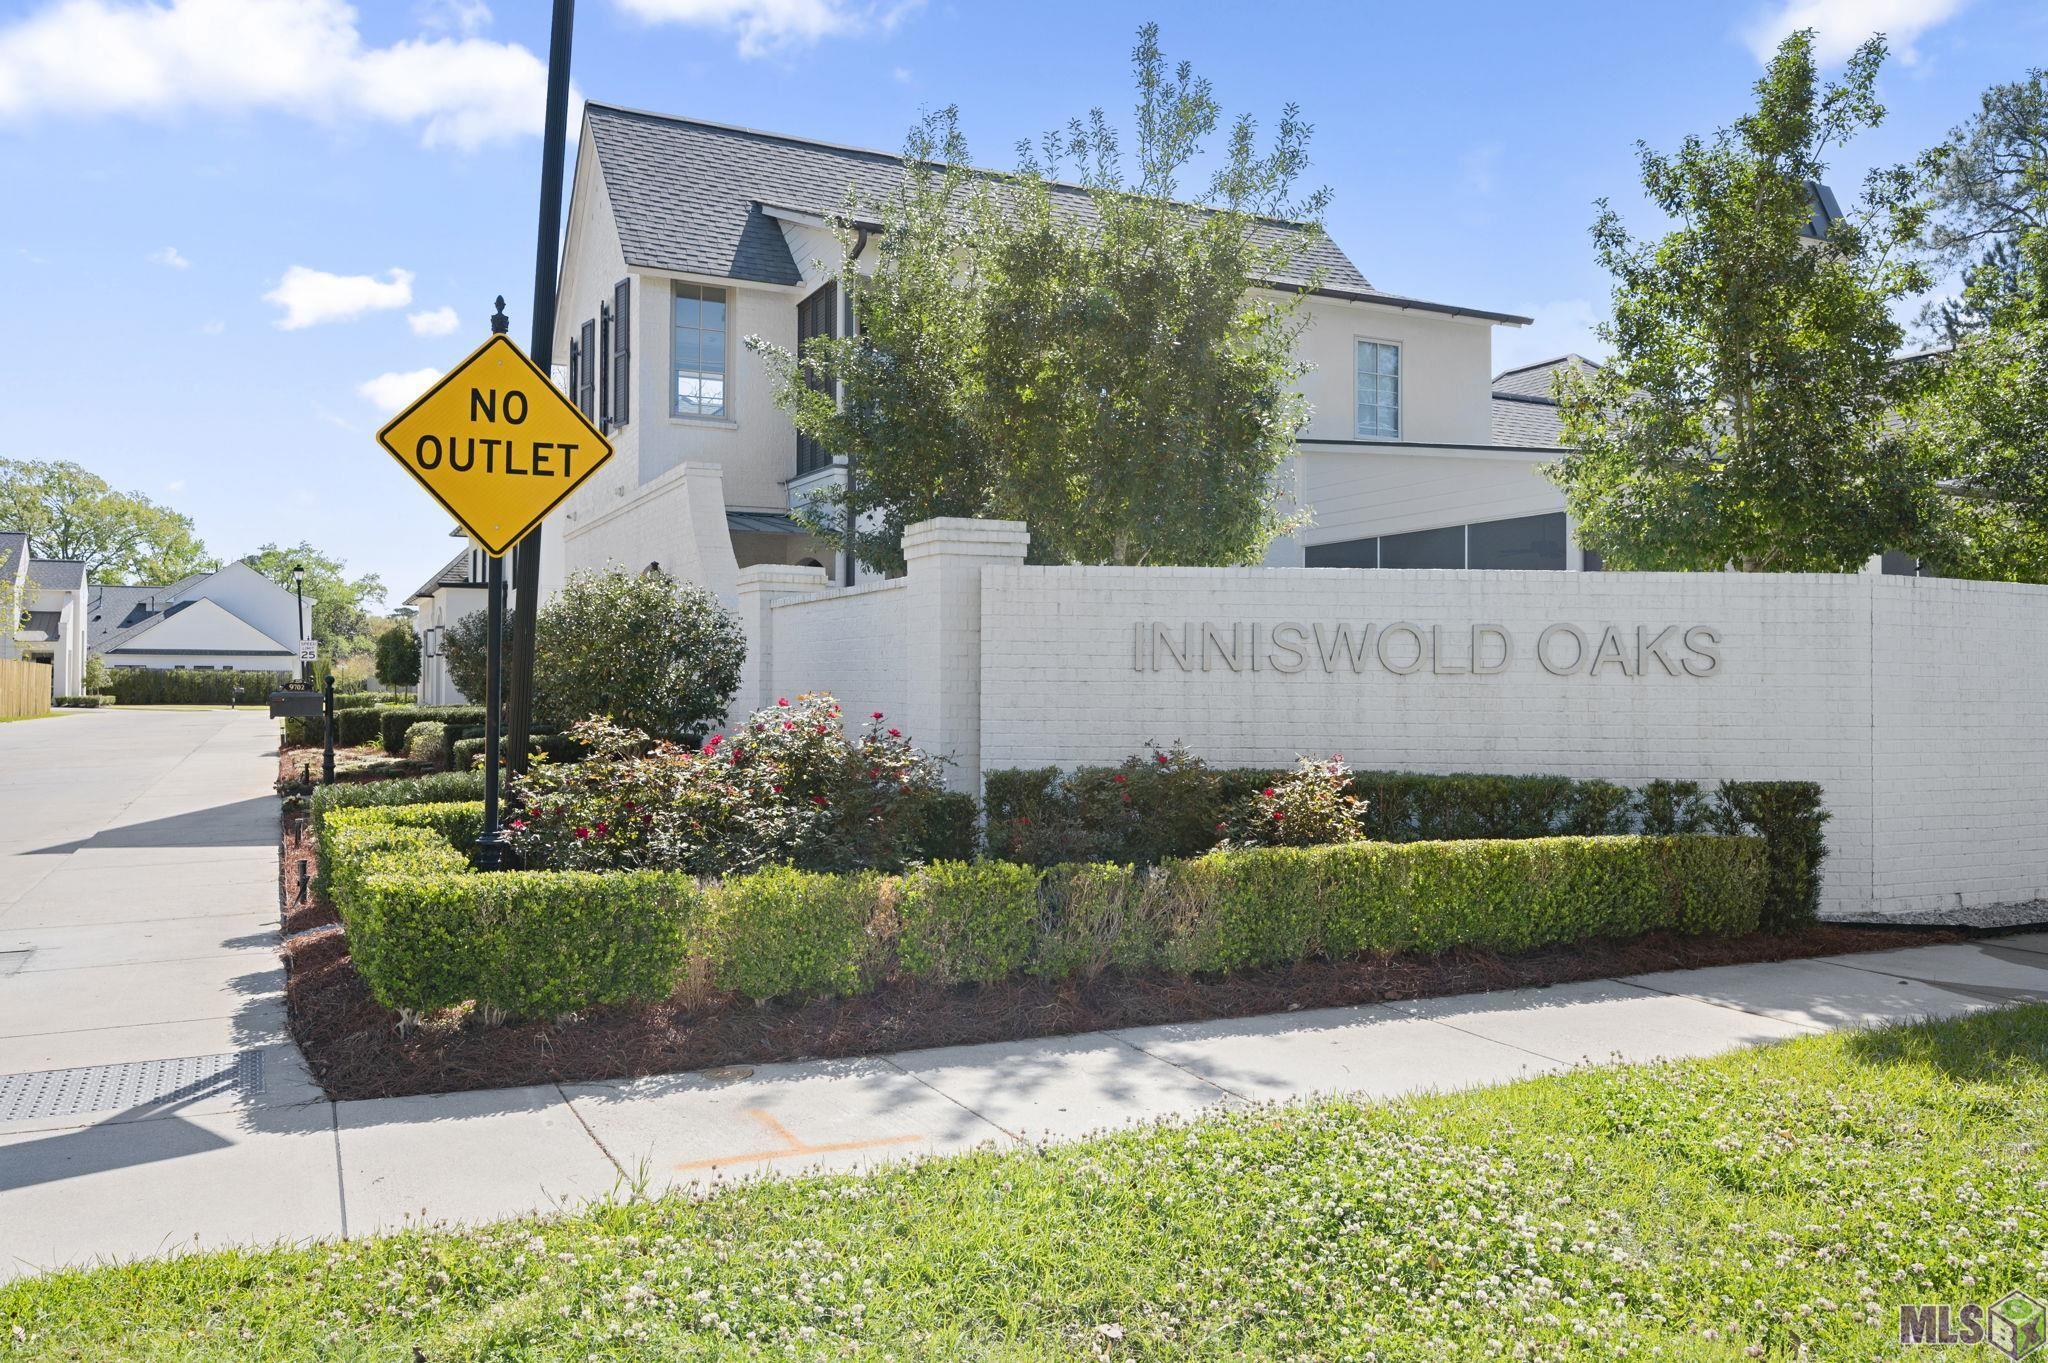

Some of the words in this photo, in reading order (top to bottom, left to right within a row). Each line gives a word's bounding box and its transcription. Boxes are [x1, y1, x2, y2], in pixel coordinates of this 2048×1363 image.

[470, 388, 529, 425] NO
[415, 435, 579, 478] OUTLET
[301, 650, 316, 659] 25
[1134, 621, 1513, 675] INNISWOLD
[1537, 622, 1721, 677] OAKS
